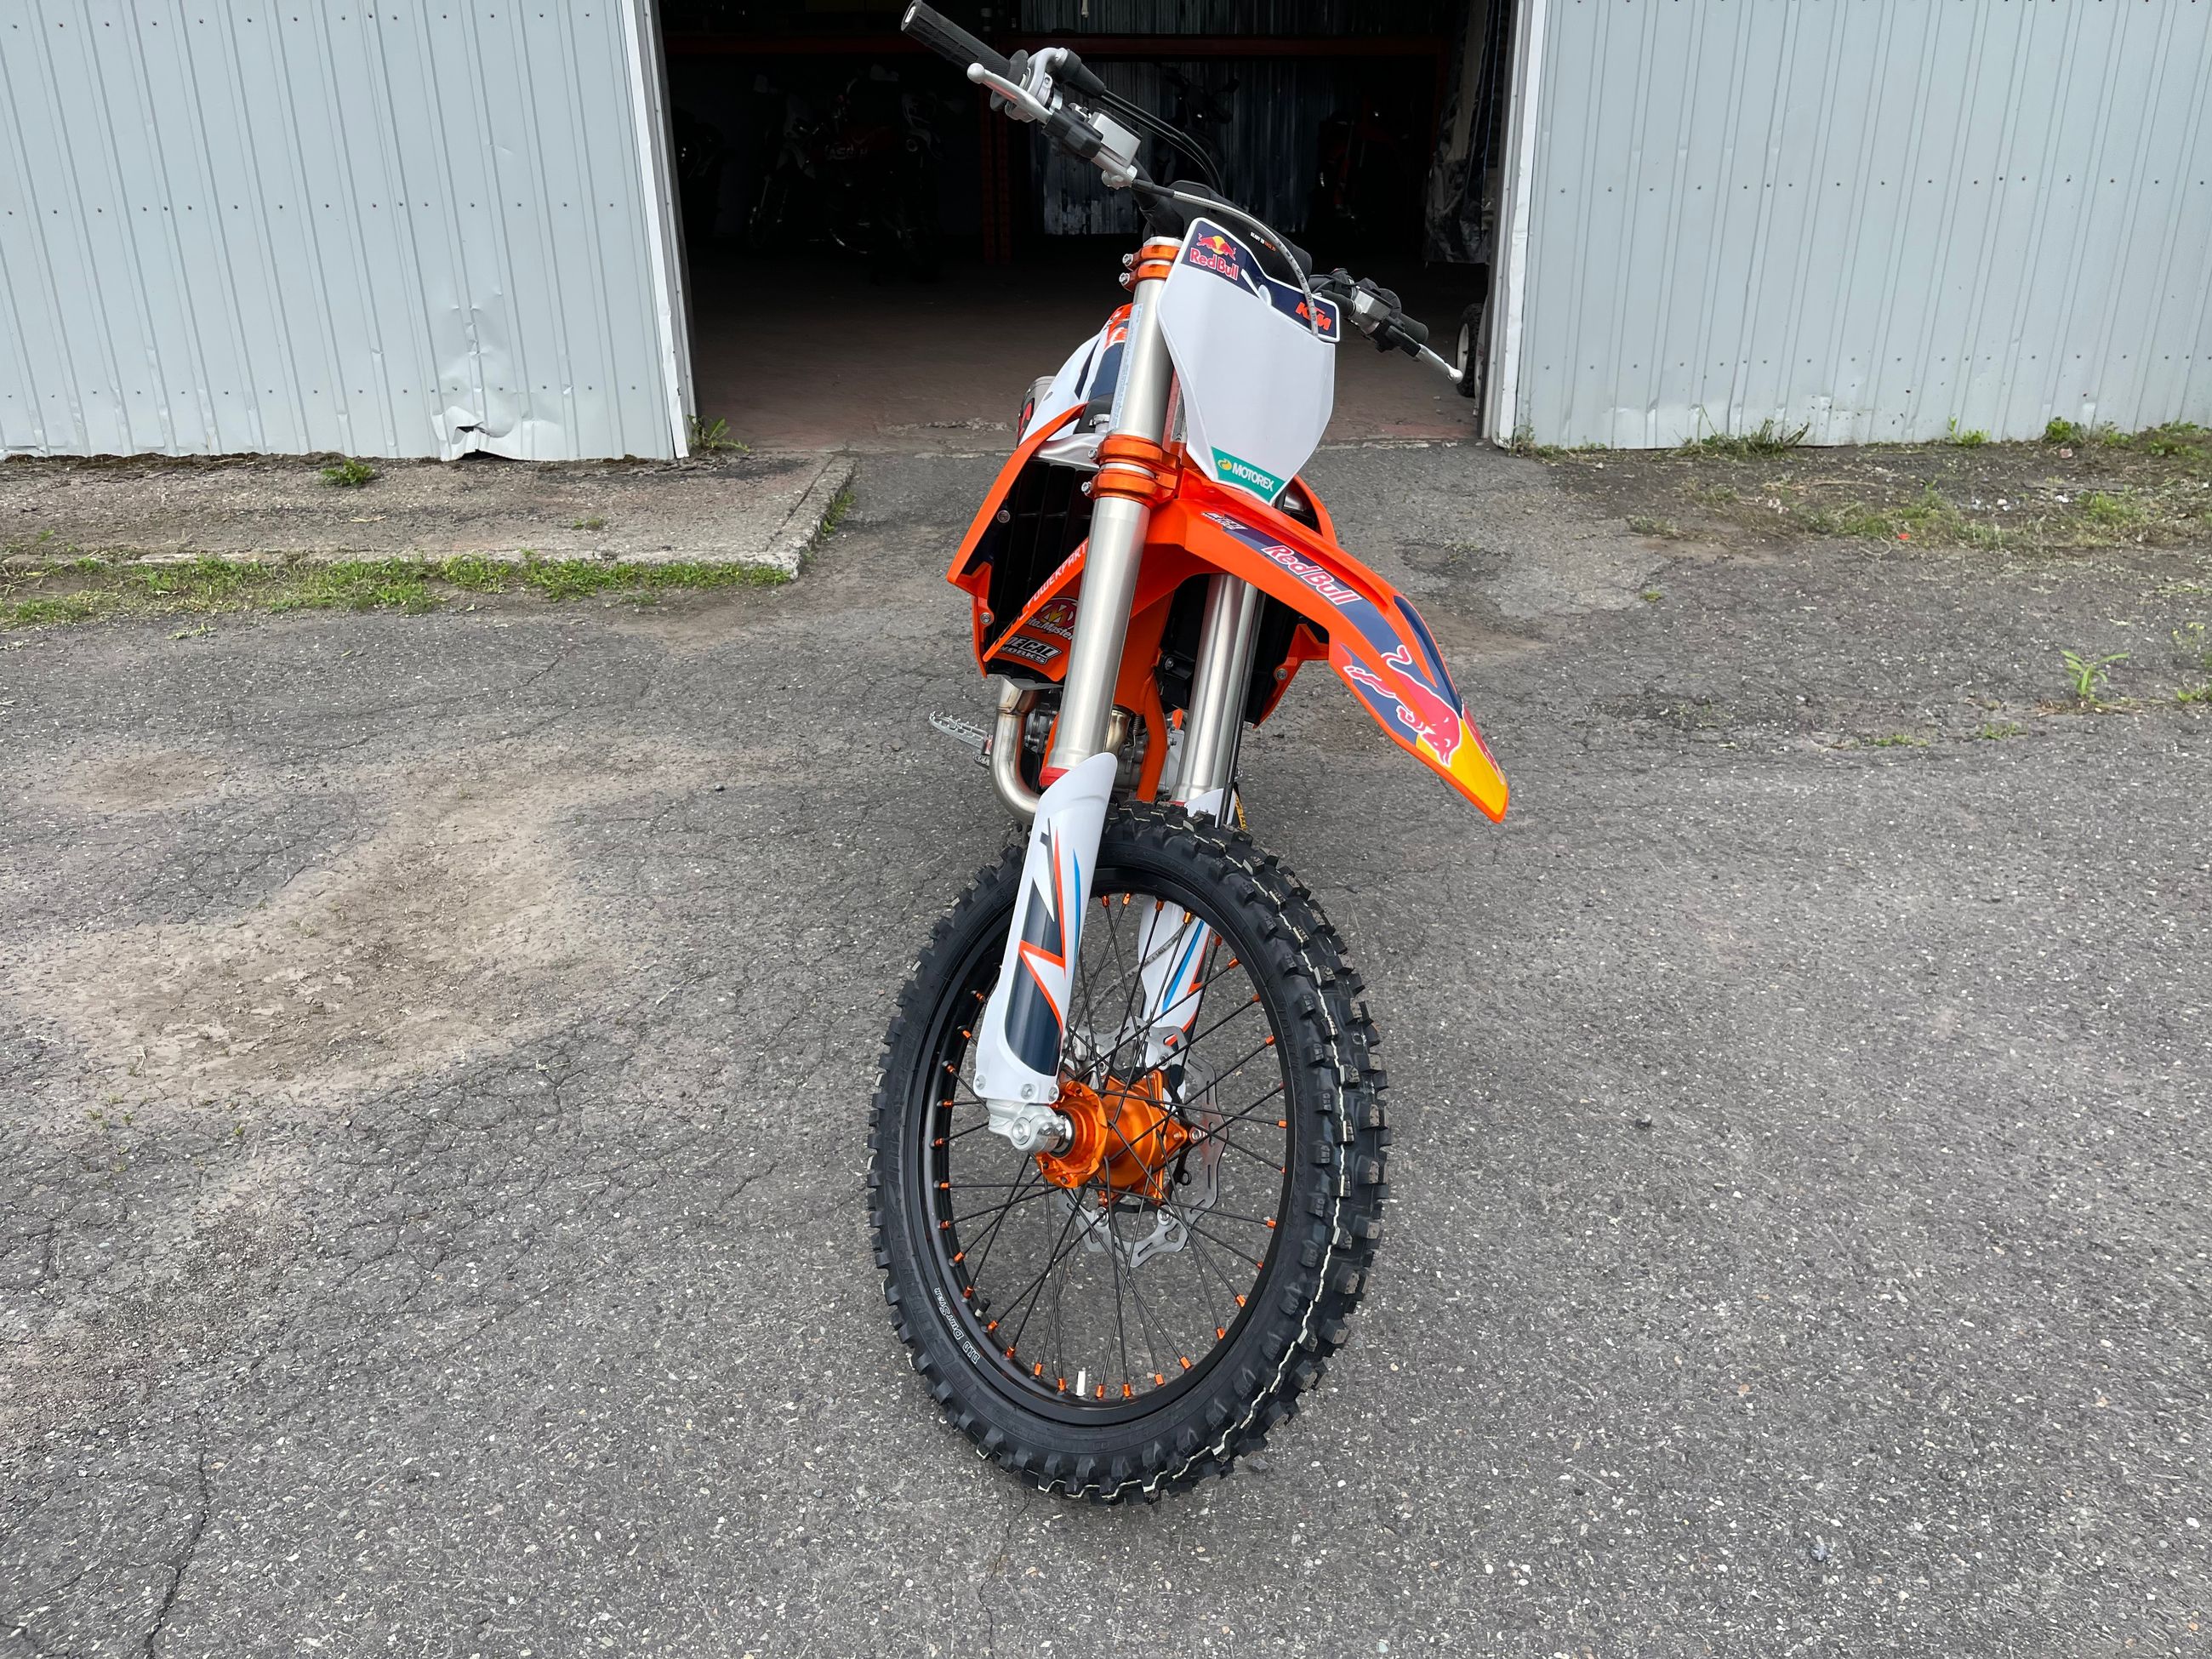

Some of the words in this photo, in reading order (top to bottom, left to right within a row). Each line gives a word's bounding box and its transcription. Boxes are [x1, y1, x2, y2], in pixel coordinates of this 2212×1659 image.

[1189, 247, 1217, 270] Red
[1217, 256, 1240, 281] Bull
[1232, 462, 1275, 493] MOTOREX
[1026, 539, 1089, 608] POWERPART
[1261, 544, 1324, 575] Red
[1300, 571, 1363, 606] Bull
[961, 1340, 981, 1365] DID
